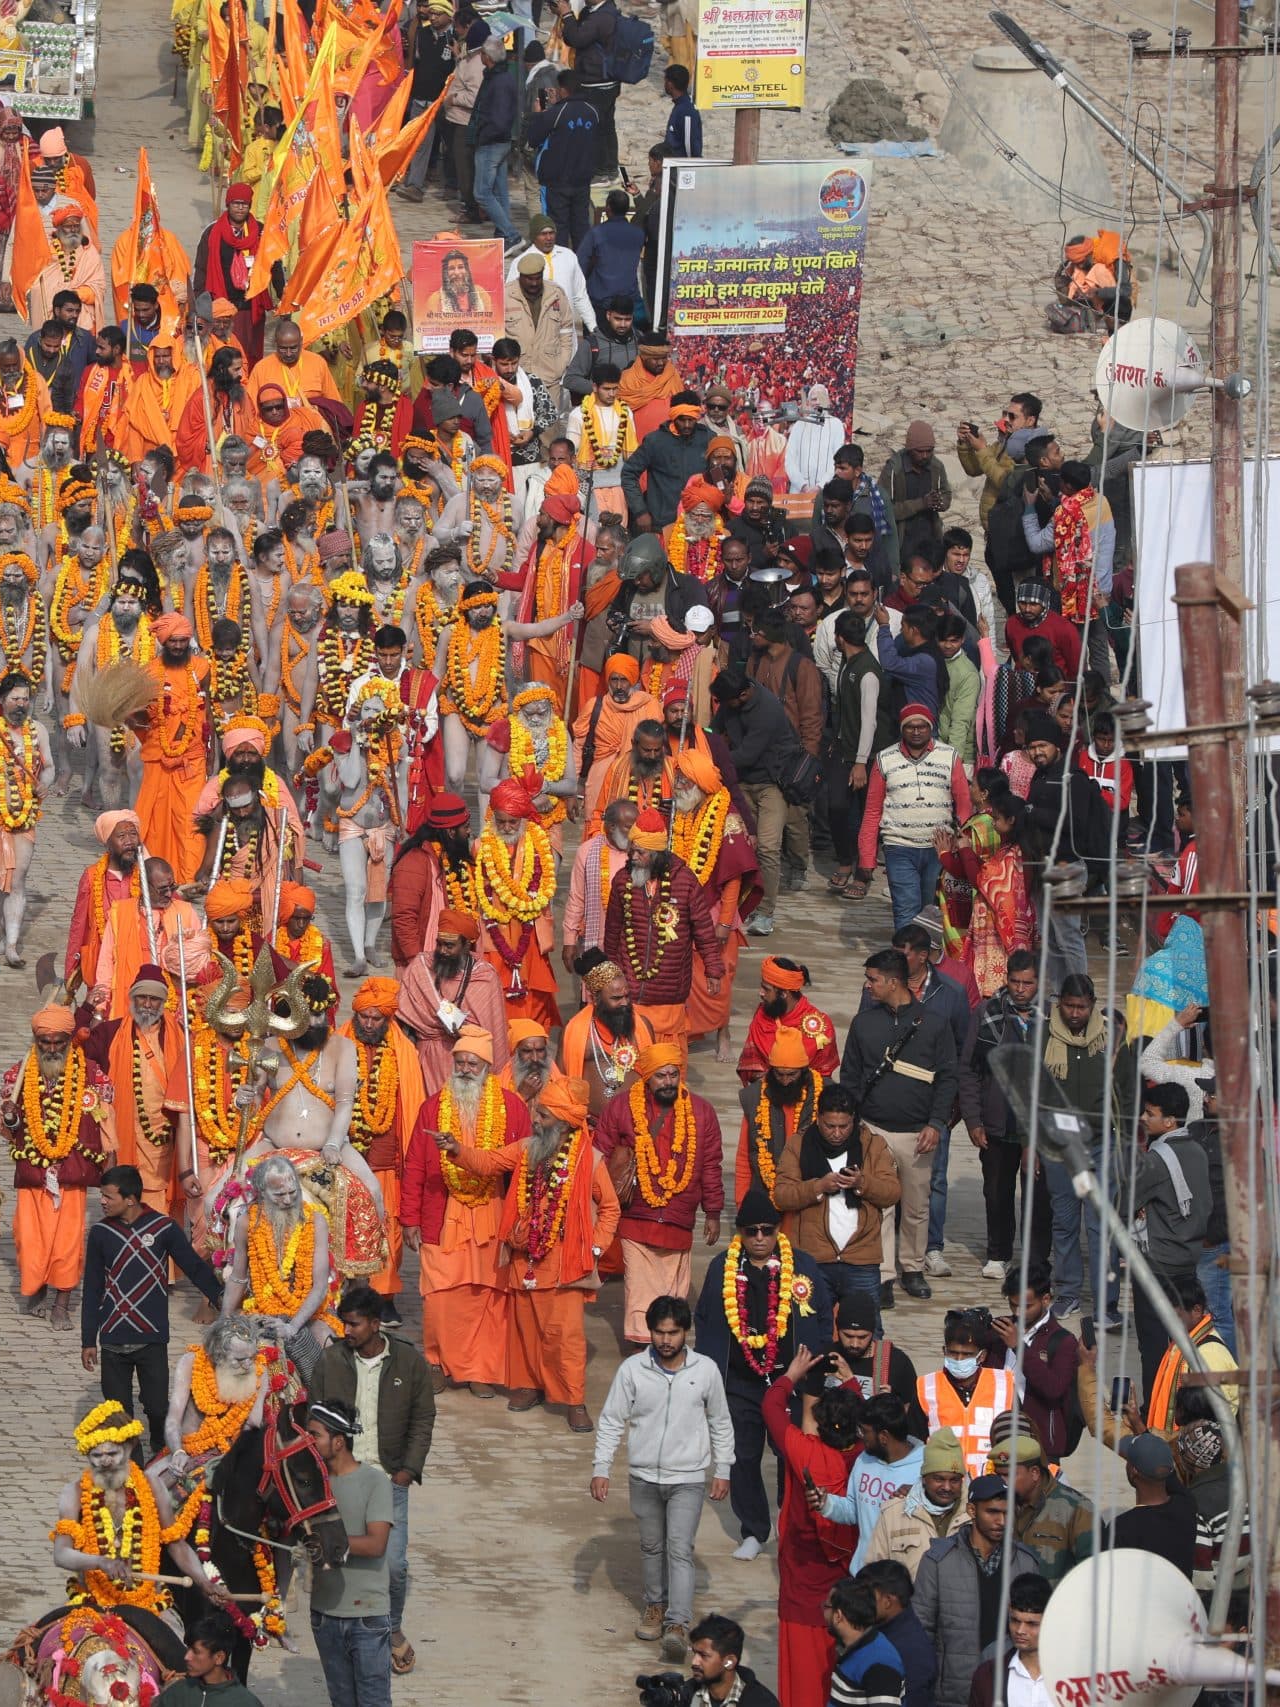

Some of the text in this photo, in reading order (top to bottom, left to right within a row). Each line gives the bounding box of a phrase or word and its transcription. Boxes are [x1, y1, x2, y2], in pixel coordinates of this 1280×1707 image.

[712, 84, 788, 93] SHYAM STEEL
[678, 250, 858, 276] जन्म-जन्मान्तर के पुण्य खिलें
[677, 276, 826, 301] आओ हम महाकुम्भ चलें
[687, 309, 783, 323] महाकुम्भ प्रयागराज 2025
